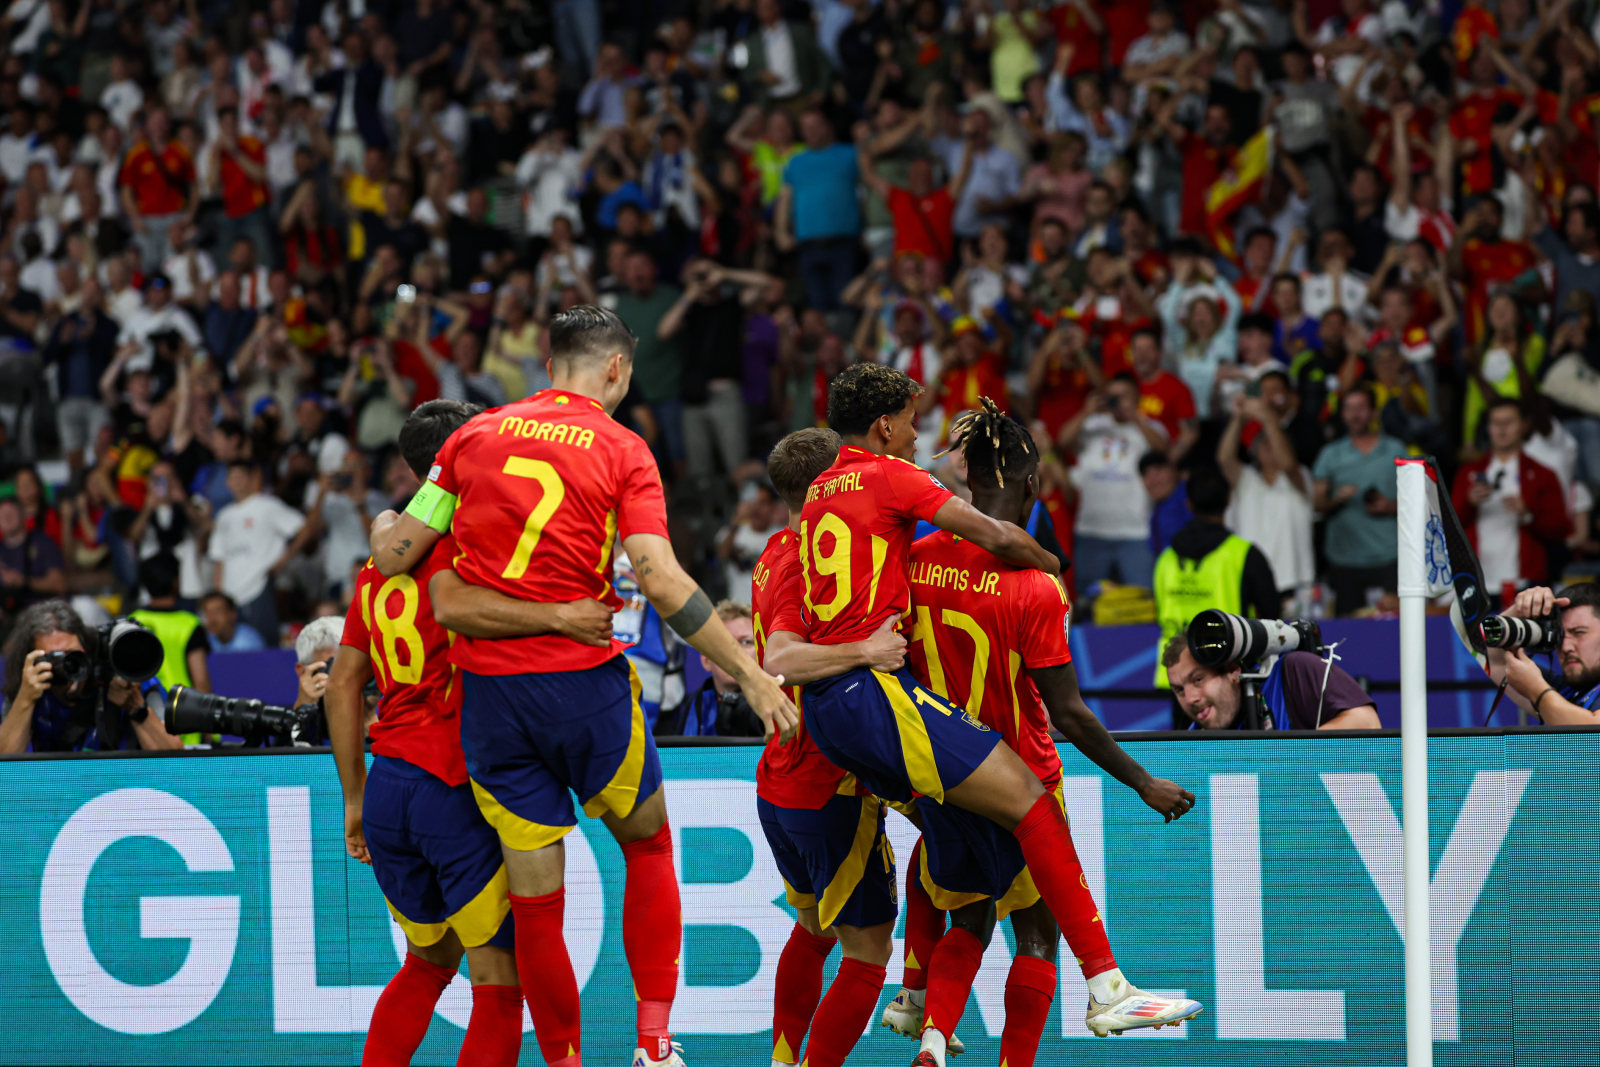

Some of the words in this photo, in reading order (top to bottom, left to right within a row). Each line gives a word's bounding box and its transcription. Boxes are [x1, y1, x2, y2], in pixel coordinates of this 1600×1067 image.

[498, 416, 595, 449] MORATA
[501, 455, 565, 579] 7
[799, 511, 852, 622] 19
[908, 561, 970, 592] ILLIAMS
[972, 570, 1002, 597] JR.
[911, 605, 990, 721] 17
